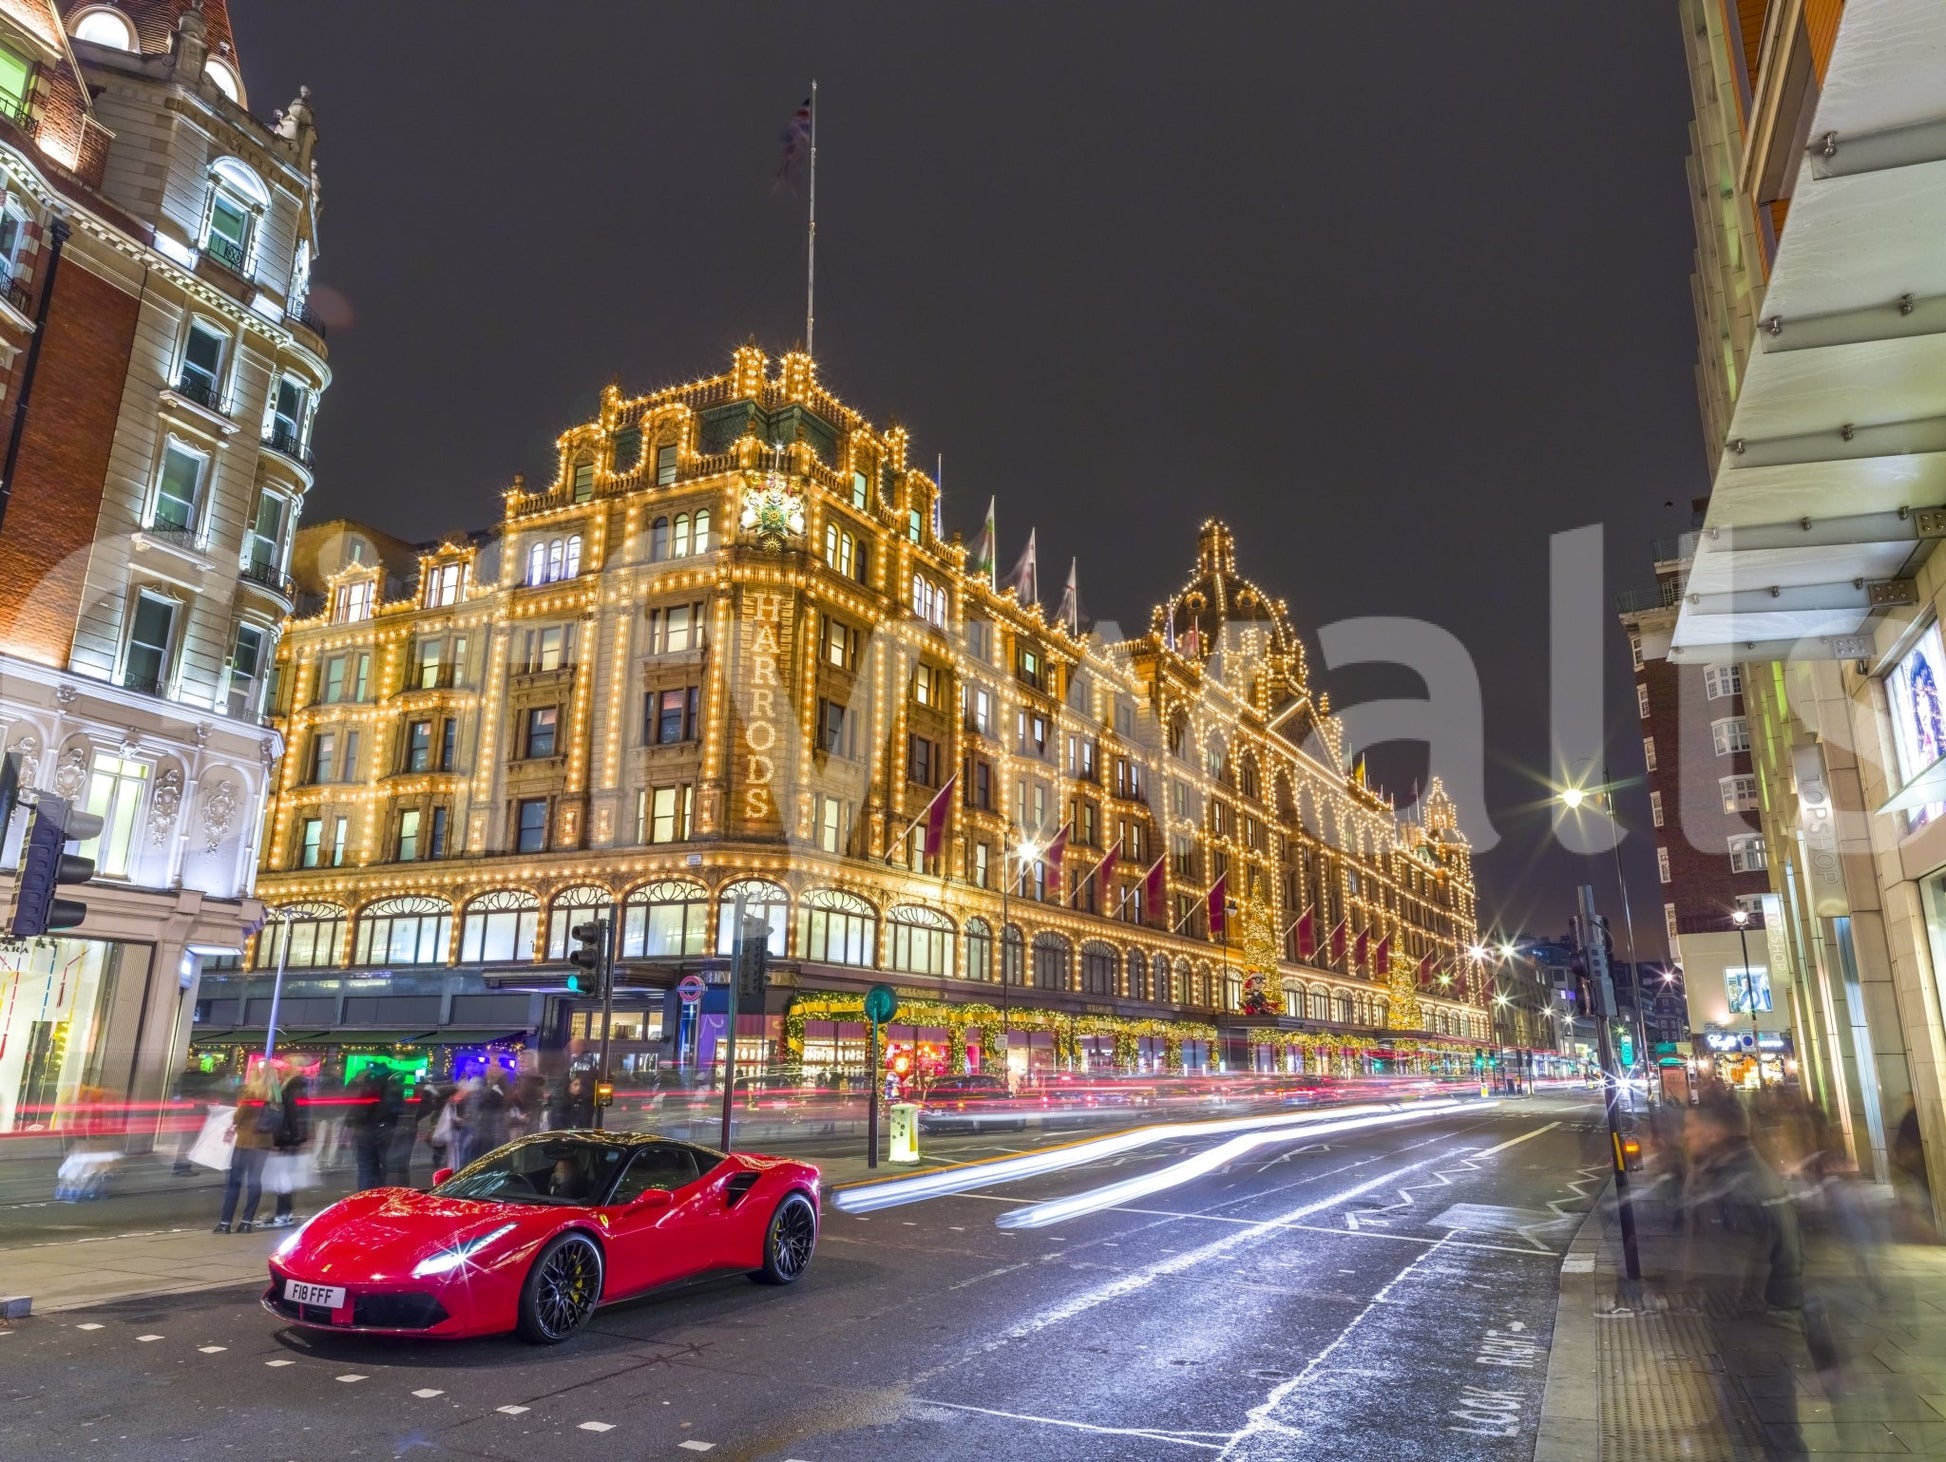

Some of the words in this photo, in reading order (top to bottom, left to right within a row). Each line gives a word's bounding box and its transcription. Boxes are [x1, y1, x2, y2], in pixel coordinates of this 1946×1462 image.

[745, 592, 782, 818] HARRODS
[1802, 773, 1840, 885] TOPSHOP
[0, 945, 29, 954] ARA
[1766, 911, 1786, 971] TOPSHOP
[292, 1283, 308, 1301] F18
[309, 1286, 334, 1304] FFF
[1475, 1329, 1536, 1368] RIGHT
[1448, 1385, 1526, 1437] LOOK
